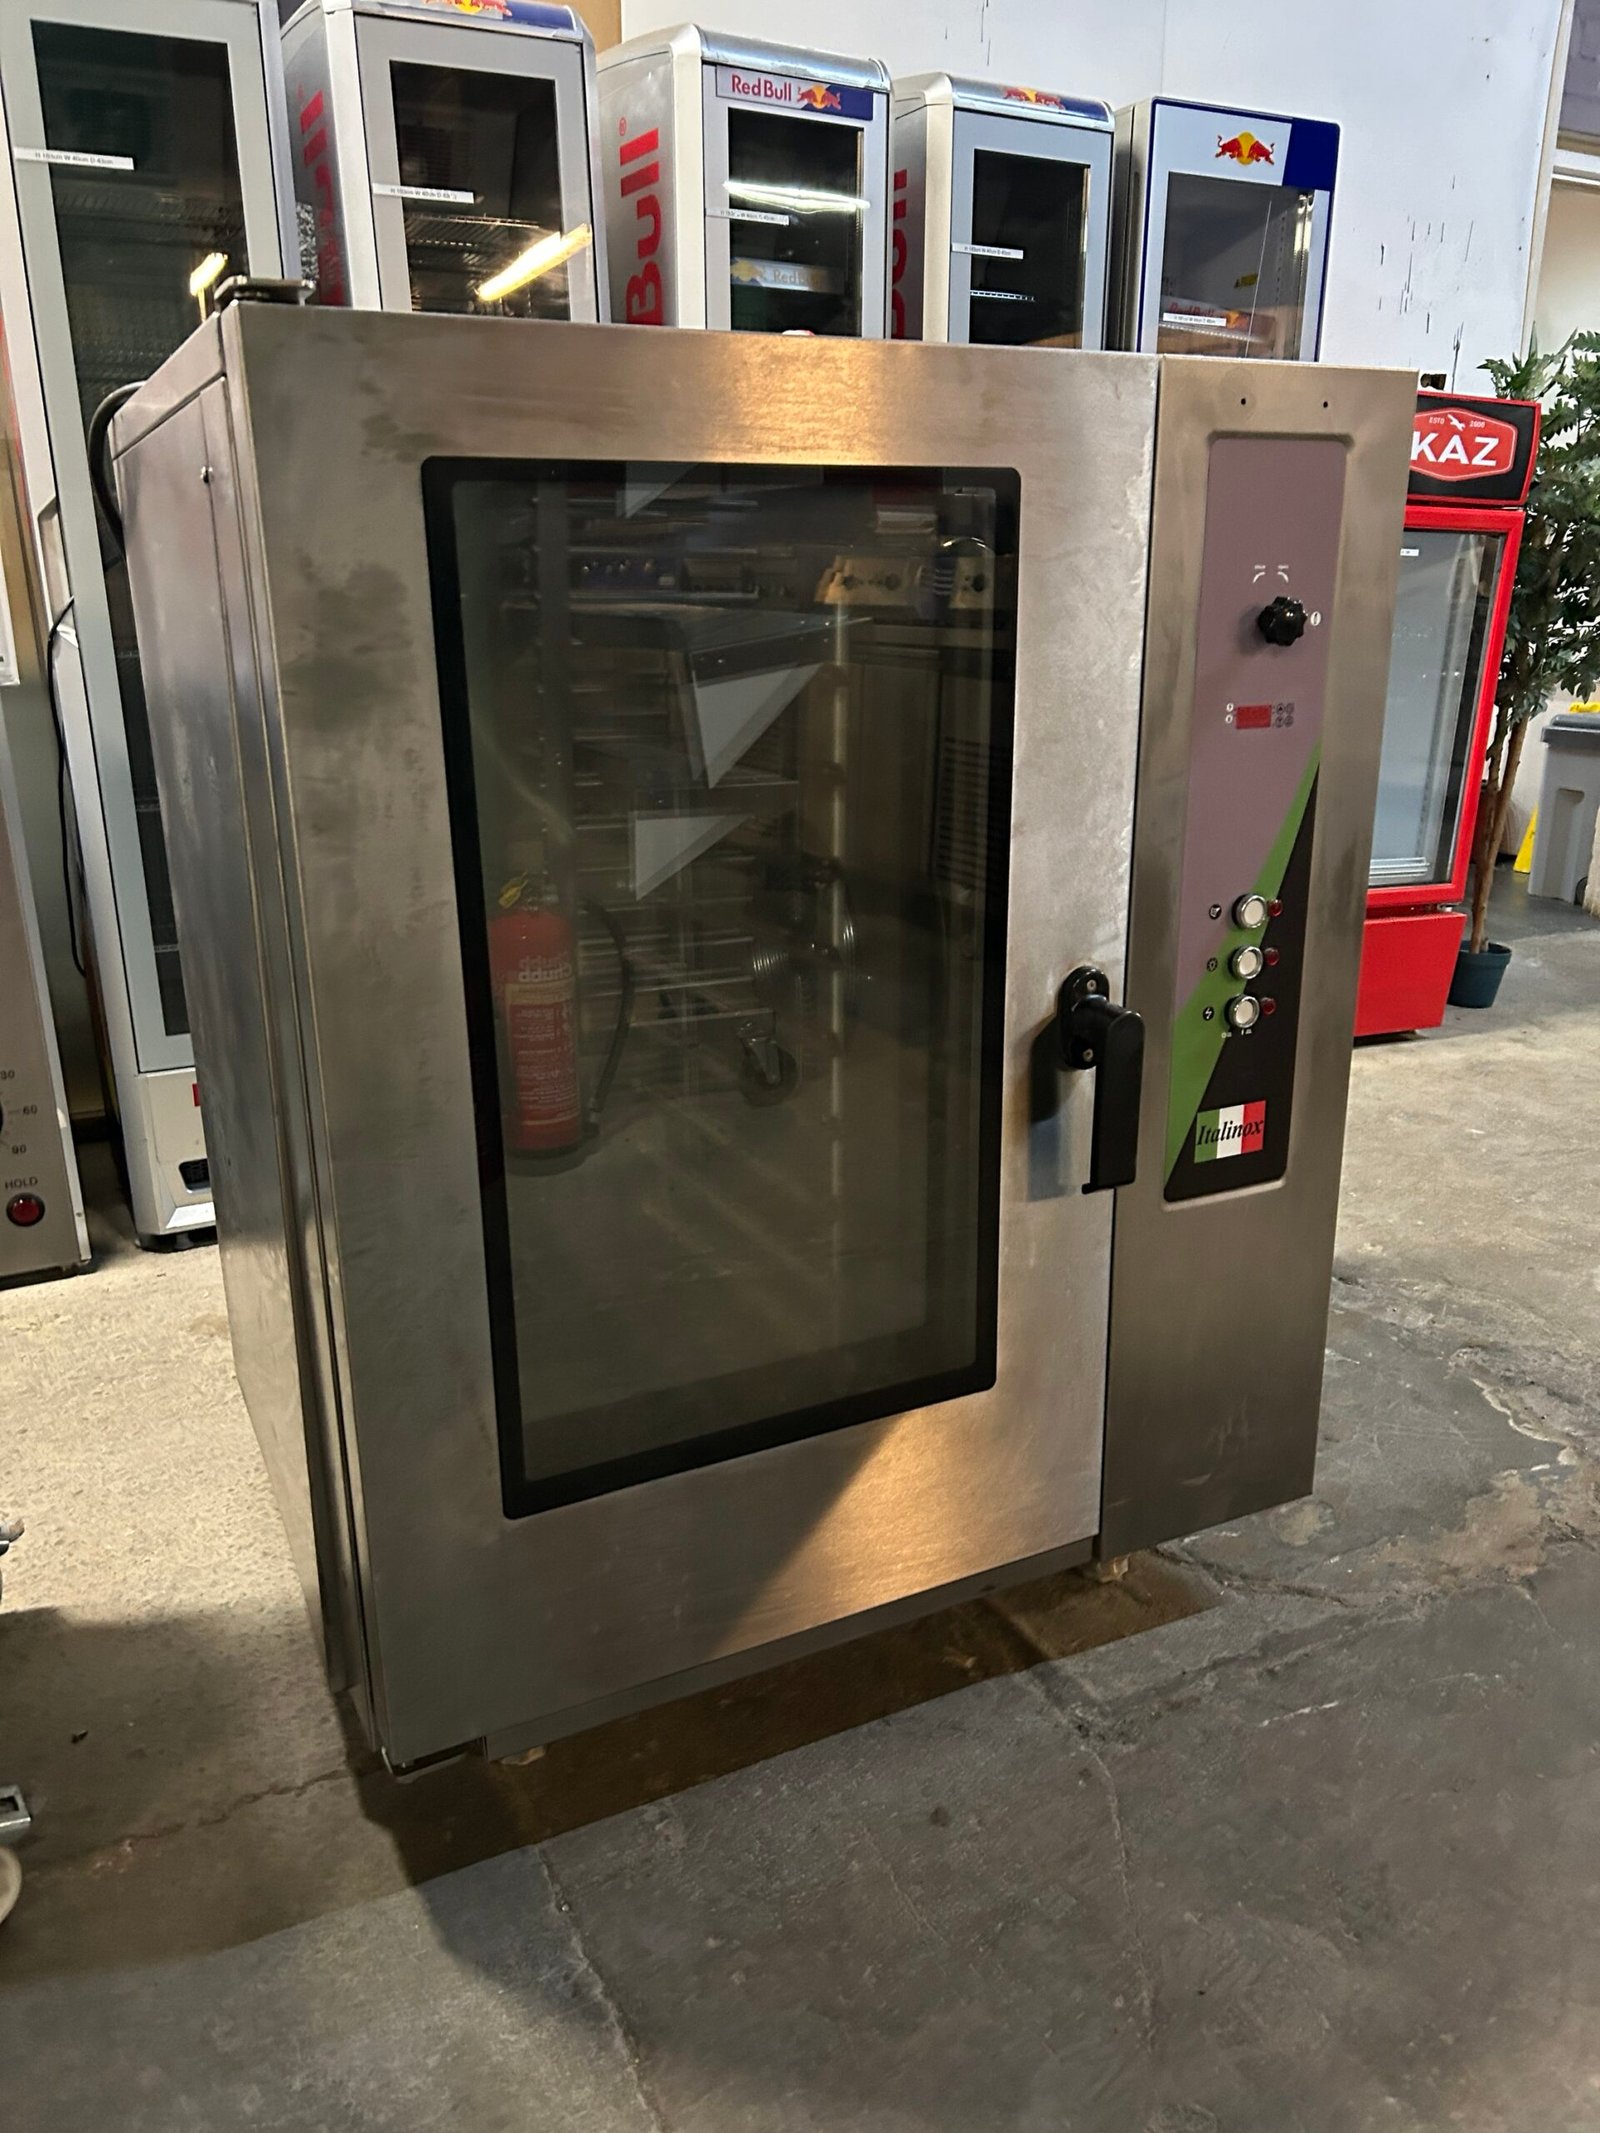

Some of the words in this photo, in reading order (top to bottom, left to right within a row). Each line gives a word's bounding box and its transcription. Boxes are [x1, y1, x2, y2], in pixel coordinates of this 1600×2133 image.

[731, 74, 761, 97] Red
[763, 79, 792, 102] Bull
[619, 127, 663, 326] Bull
[1411, 431, 1499, 466] KAZ
[23, 1105, 38, 1115] 60
[1197, 1120, 1264, 1146] Italinox
[12, 1144, 27, 1154] 90
[5, 1176, 38, 1189] HOLD
